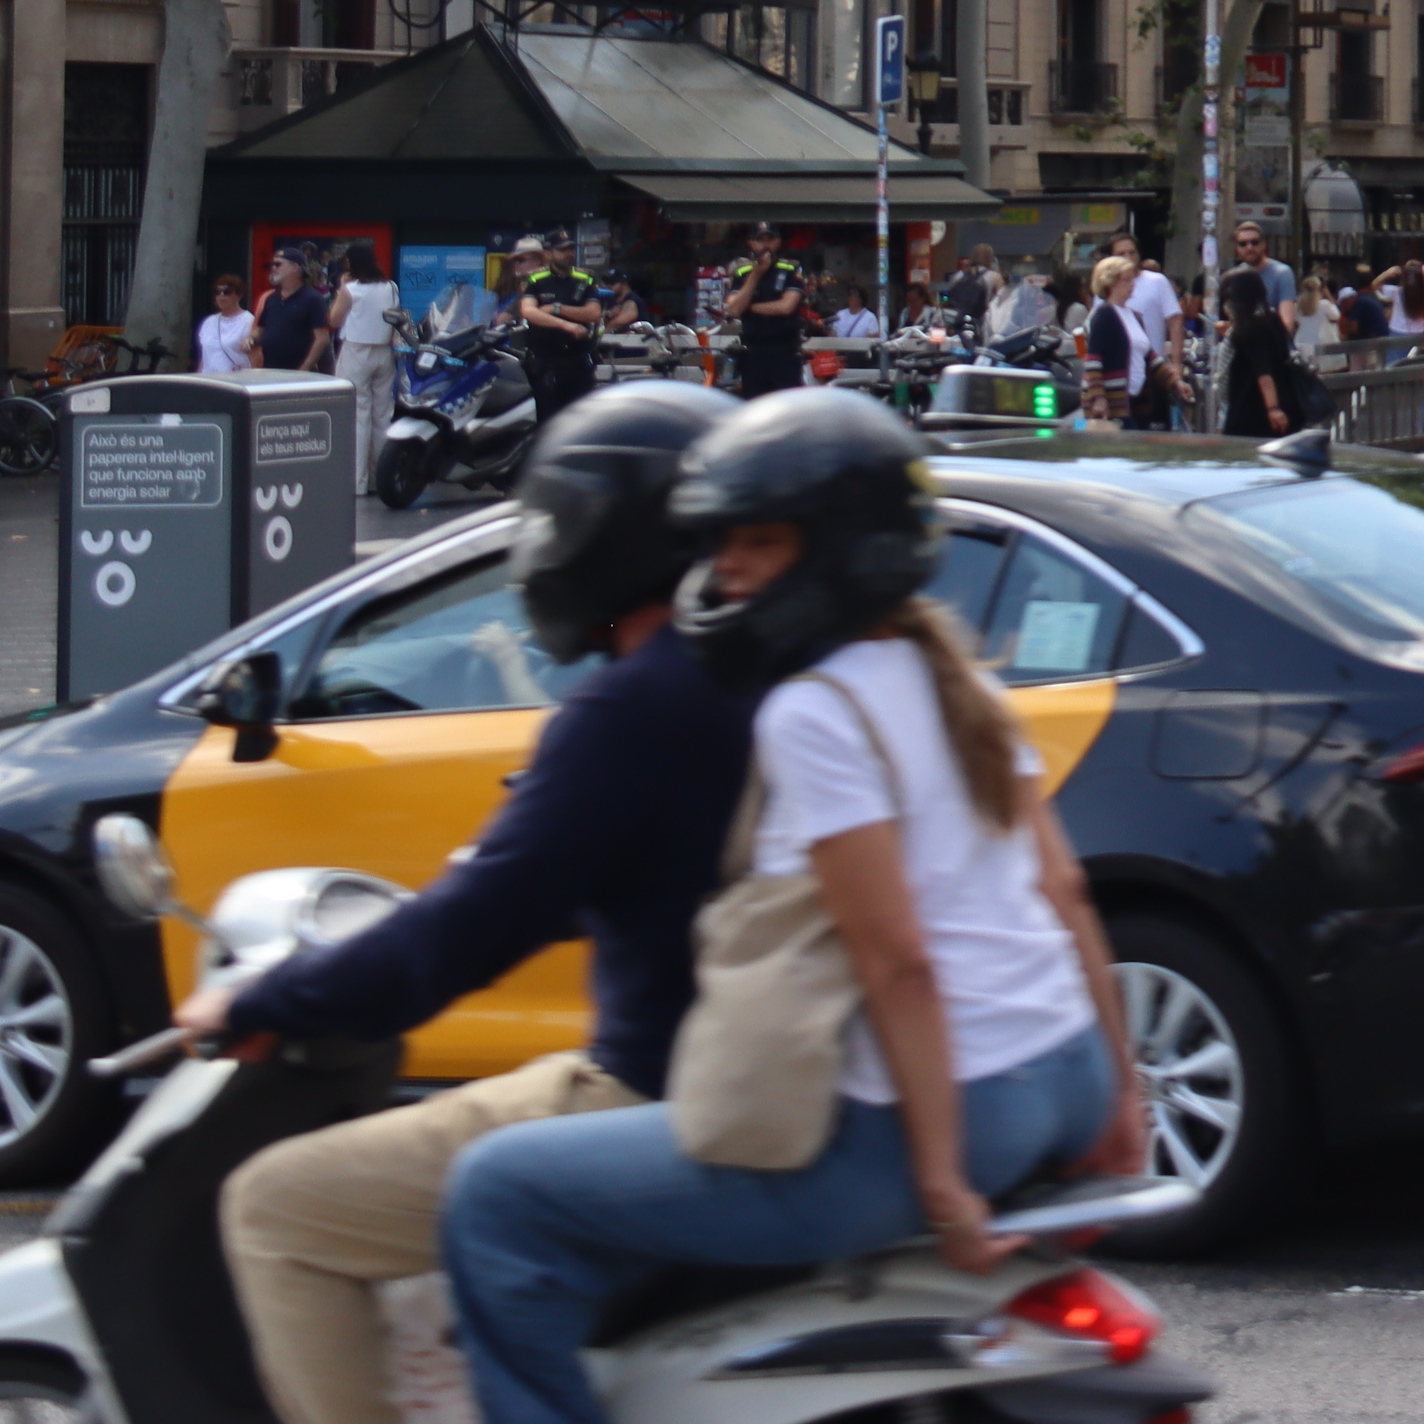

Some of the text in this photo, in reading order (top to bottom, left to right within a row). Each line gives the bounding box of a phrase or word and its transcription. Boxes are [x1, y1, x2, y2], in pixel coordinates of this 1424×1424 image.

[888, 30, 898, 62] P
[89, 433, 164, 447] Això és una
[260, 424, 290, 439] Llença
[260, 438, 327, 455] els teus residus
[89, 452, 148, 467] paperera
[89, 467, 207, 484] que funciona amb
[89, 484, 171, 501] energia solar
